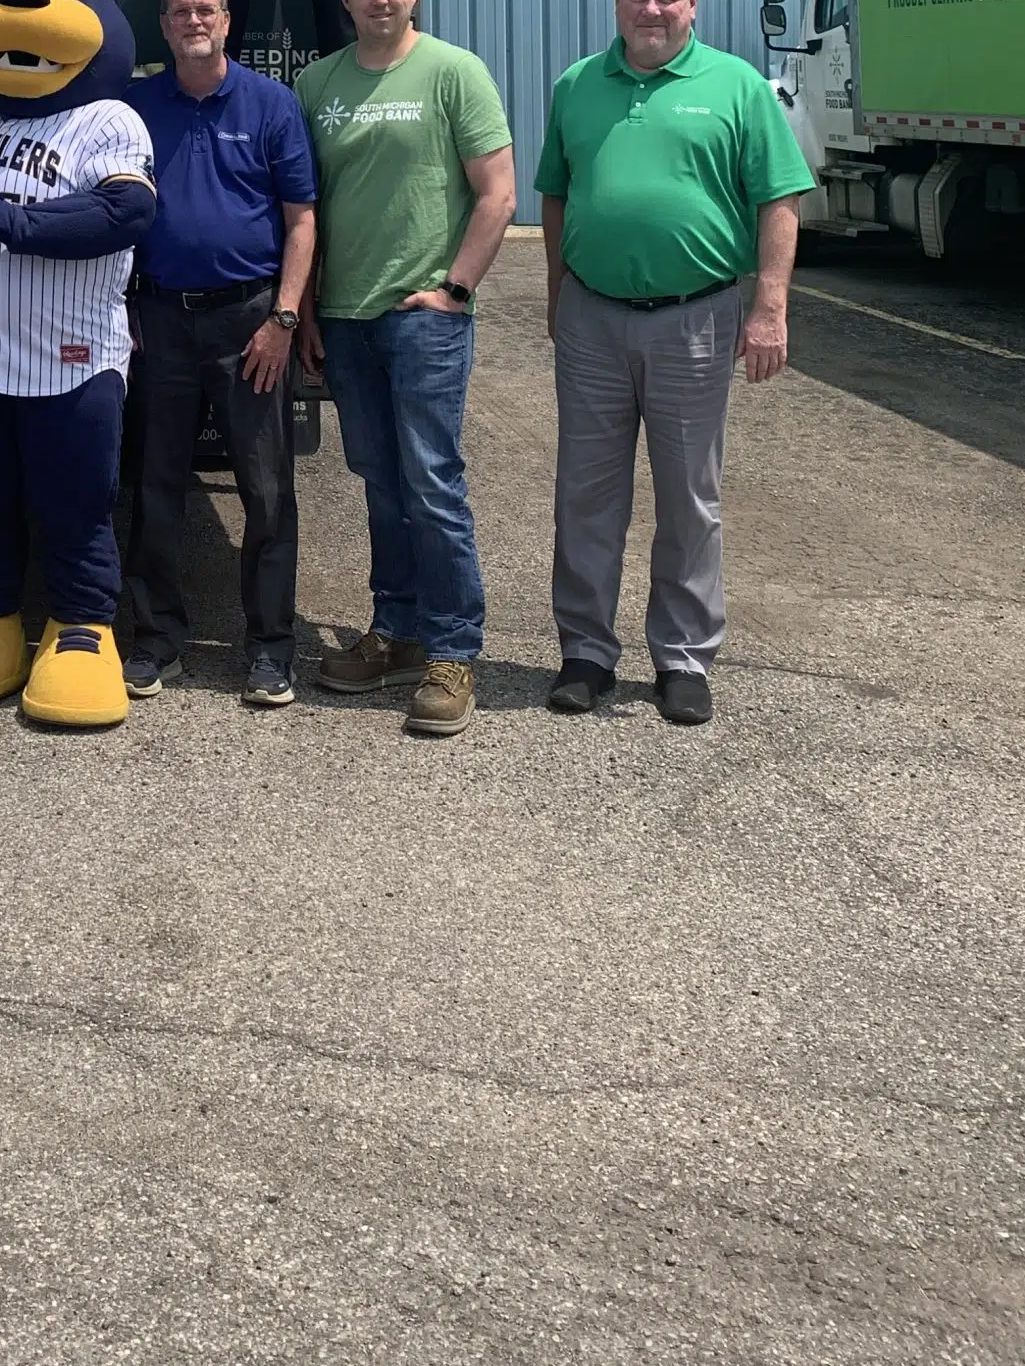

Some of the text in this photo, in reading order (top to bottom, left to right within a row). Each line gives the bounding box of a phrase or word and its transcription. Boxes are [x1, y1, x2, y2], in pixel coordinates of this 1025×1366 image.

[355, 101, 423, 113] SOUTH MICHIGAN
[825, 98, 839, 109] FOOD
[352, 109, 422, 123] FOOD BANK
